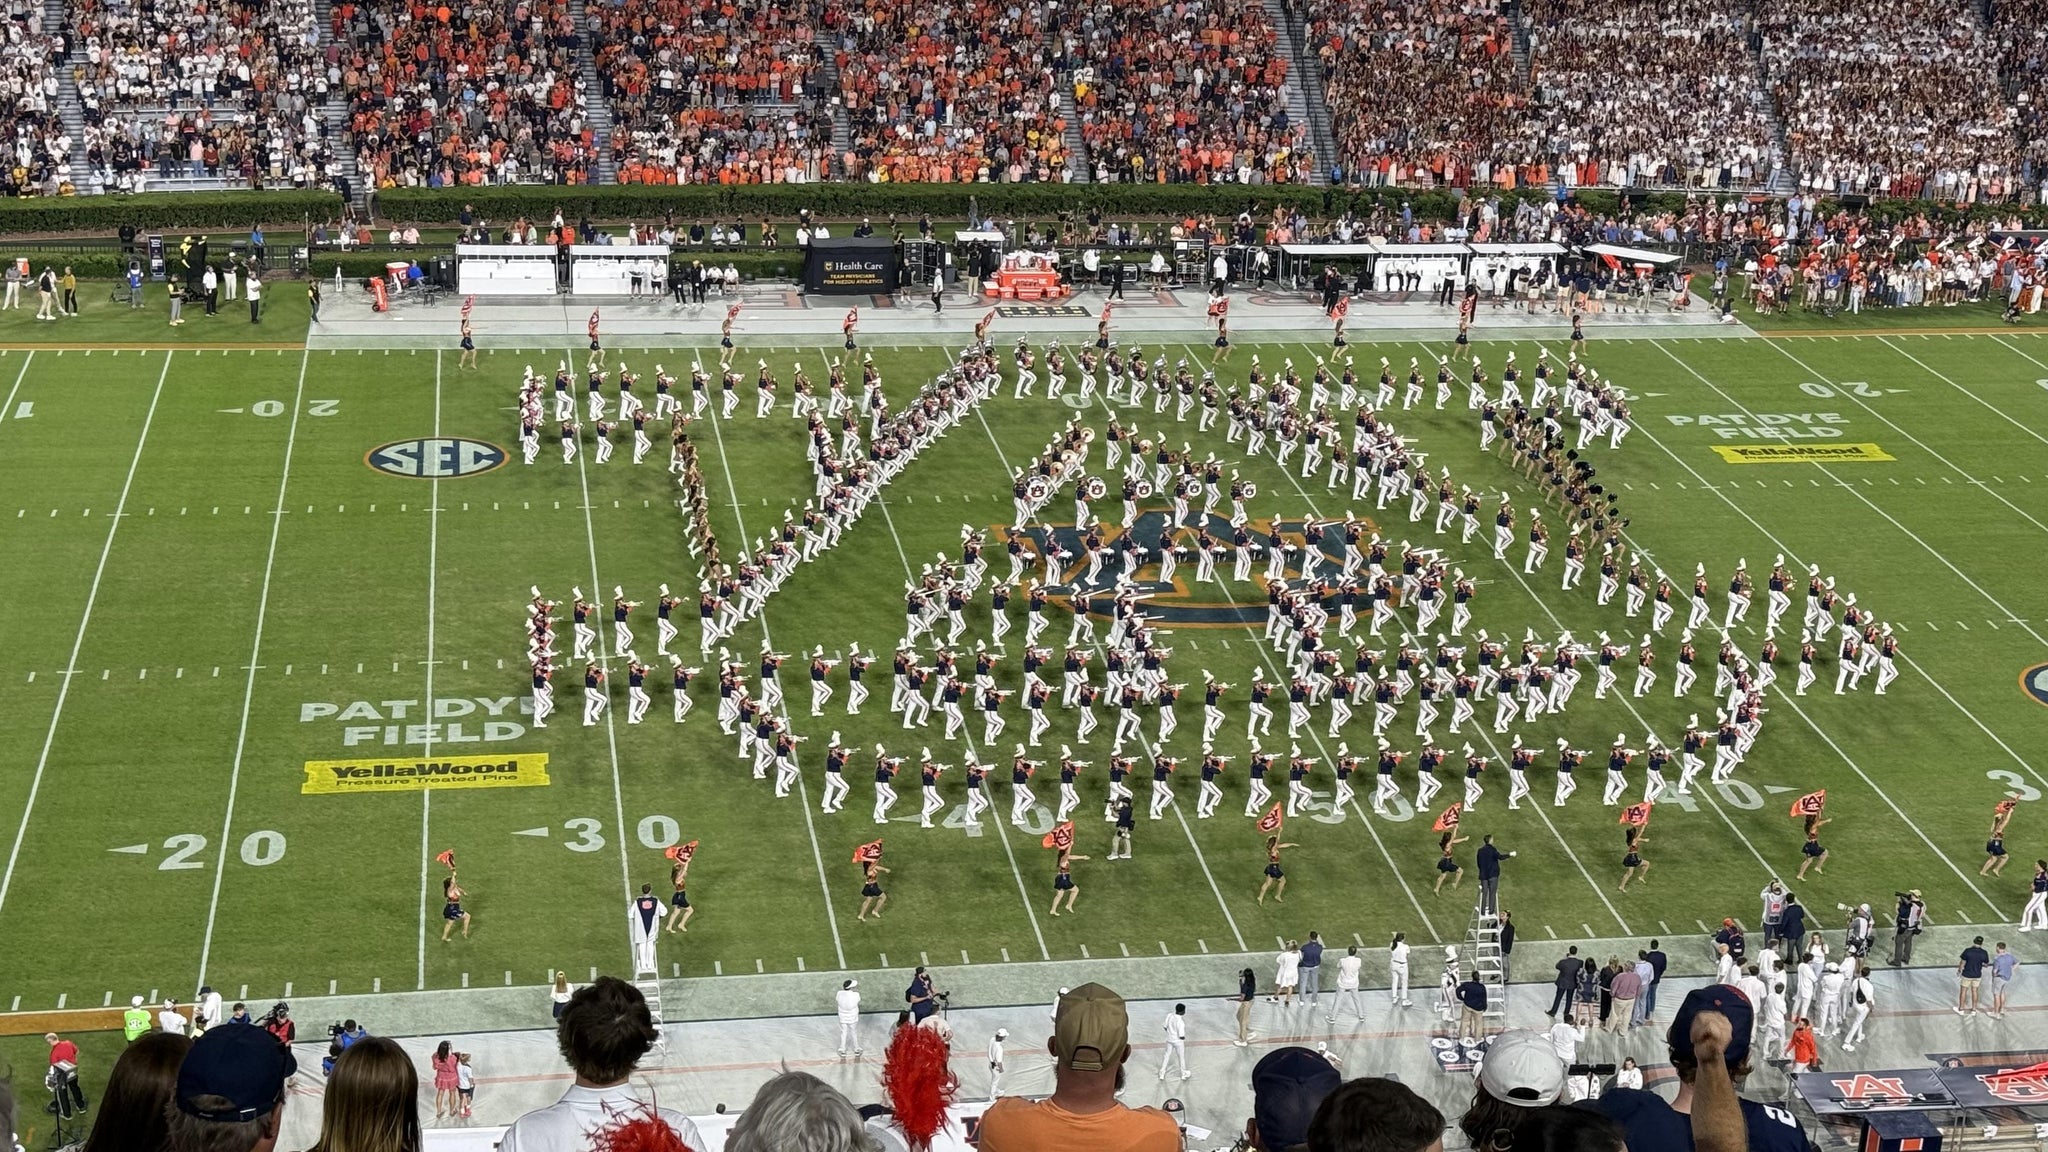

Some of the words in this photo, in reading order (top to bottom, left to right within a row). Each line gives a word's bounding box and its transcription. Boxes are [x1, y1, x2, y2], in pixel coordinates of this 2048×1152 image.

[835, 261, 863, 271] Health
[864, 261, 884, 271] Care
[1665, 413, 1748, 426] PAT
[1755, 412, 1850, 425] DYE
[1712, 426, 1844, 439] FIELD
[378, 439, 497, 476] SEC
[1730, 446, 1865, 456] YellaWood
[300, 699, 418, 722] PAT
[343, 721, 526, 746] FIELD
[330, 760, 518, 779] YellaWood
[336, 777, 410, 786] Pressure
[414, 776, 477, 784] Treated
